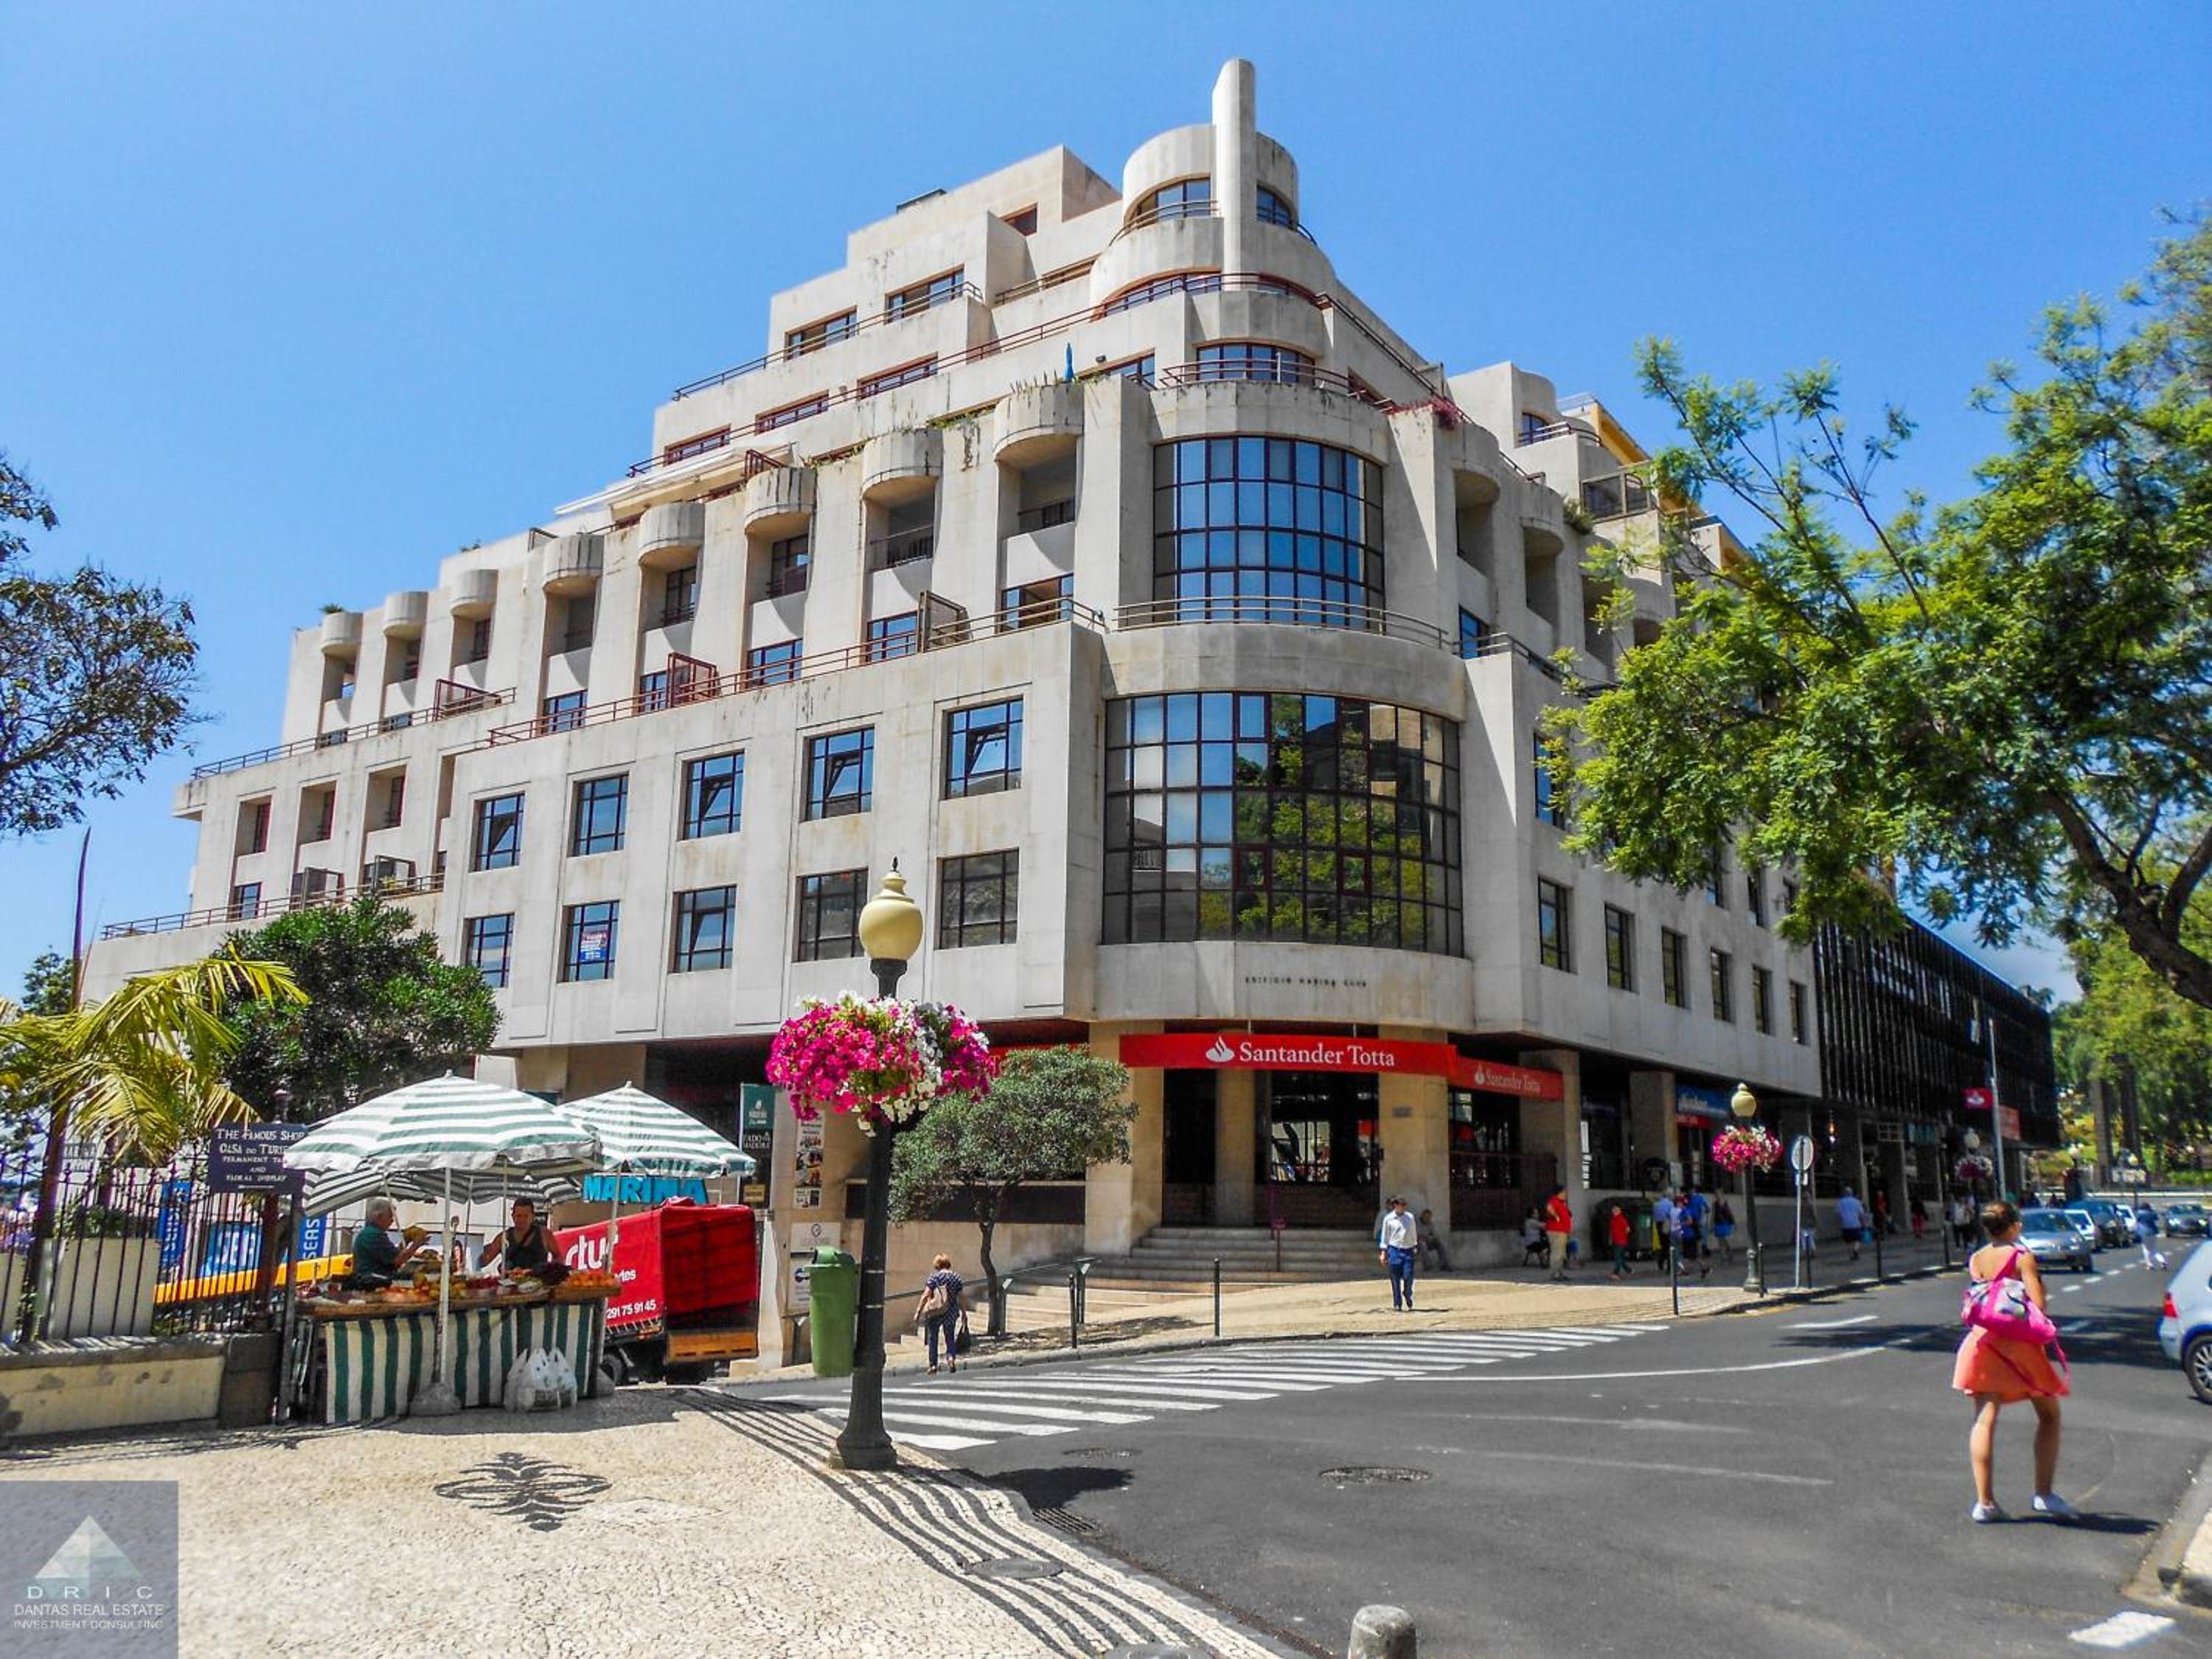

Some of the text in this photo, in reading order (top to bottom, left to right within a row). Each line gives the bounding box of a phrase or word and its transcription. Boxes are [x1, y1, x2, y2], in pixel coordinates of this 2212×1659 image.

[1239, 1042, 1395, 1066] Santander Totta
[216, 1129, 240, 1139] THE
[582, 1174, 708, 1204] MARINA
[622, 1304, 633, 1316] 75
[633, 1302, 644, 1314] 91
[644, 1298, 657, 1311] 45
